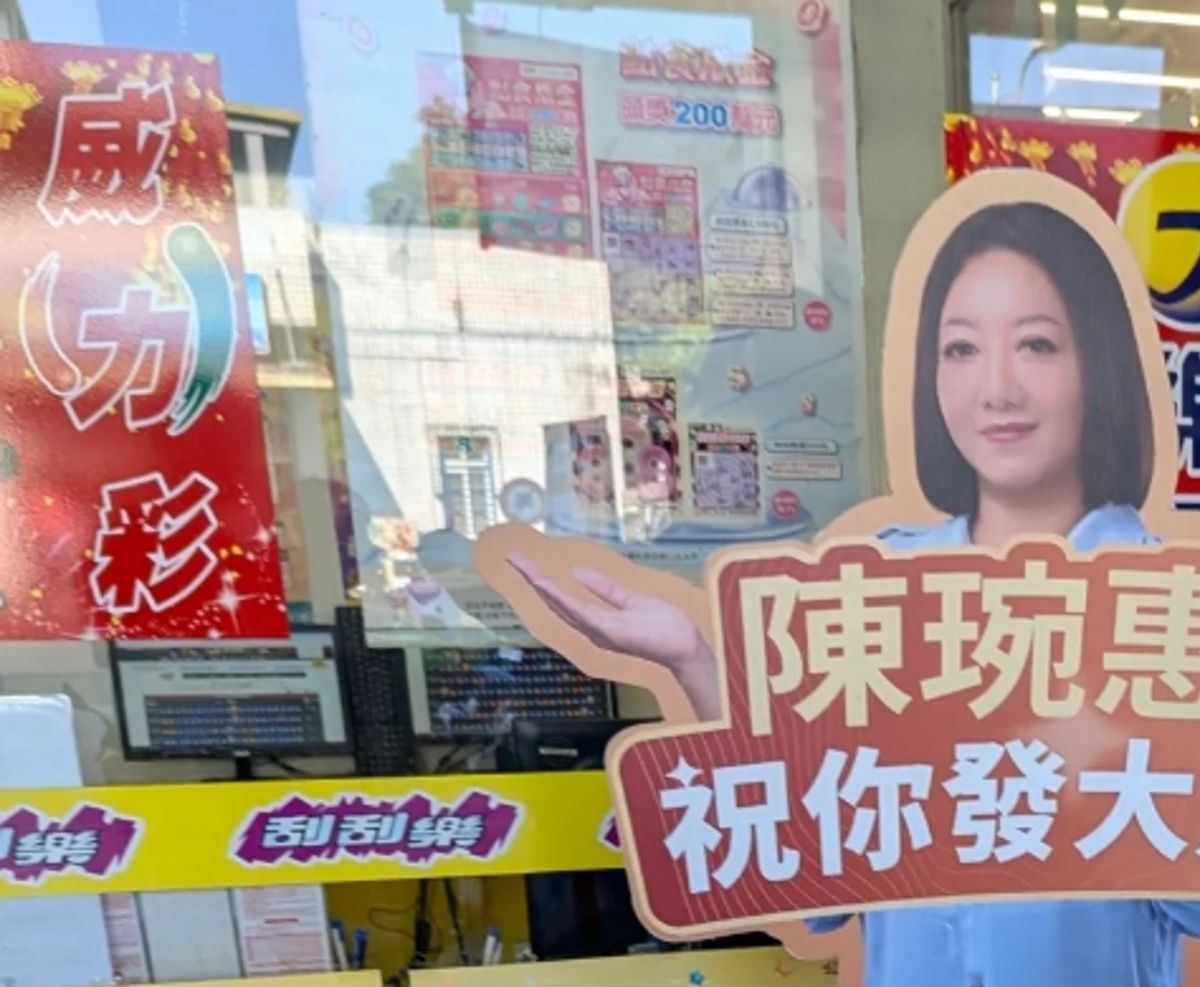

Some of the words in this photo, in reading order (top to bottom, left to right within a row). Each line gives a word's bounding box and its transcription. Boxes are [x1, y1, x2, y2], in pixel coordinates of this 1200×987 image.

[36, 80, 222, 614] 威力彩
[0, 828, 98, 866] 樂
[262, 812, 484, 848] 刮刮樂
